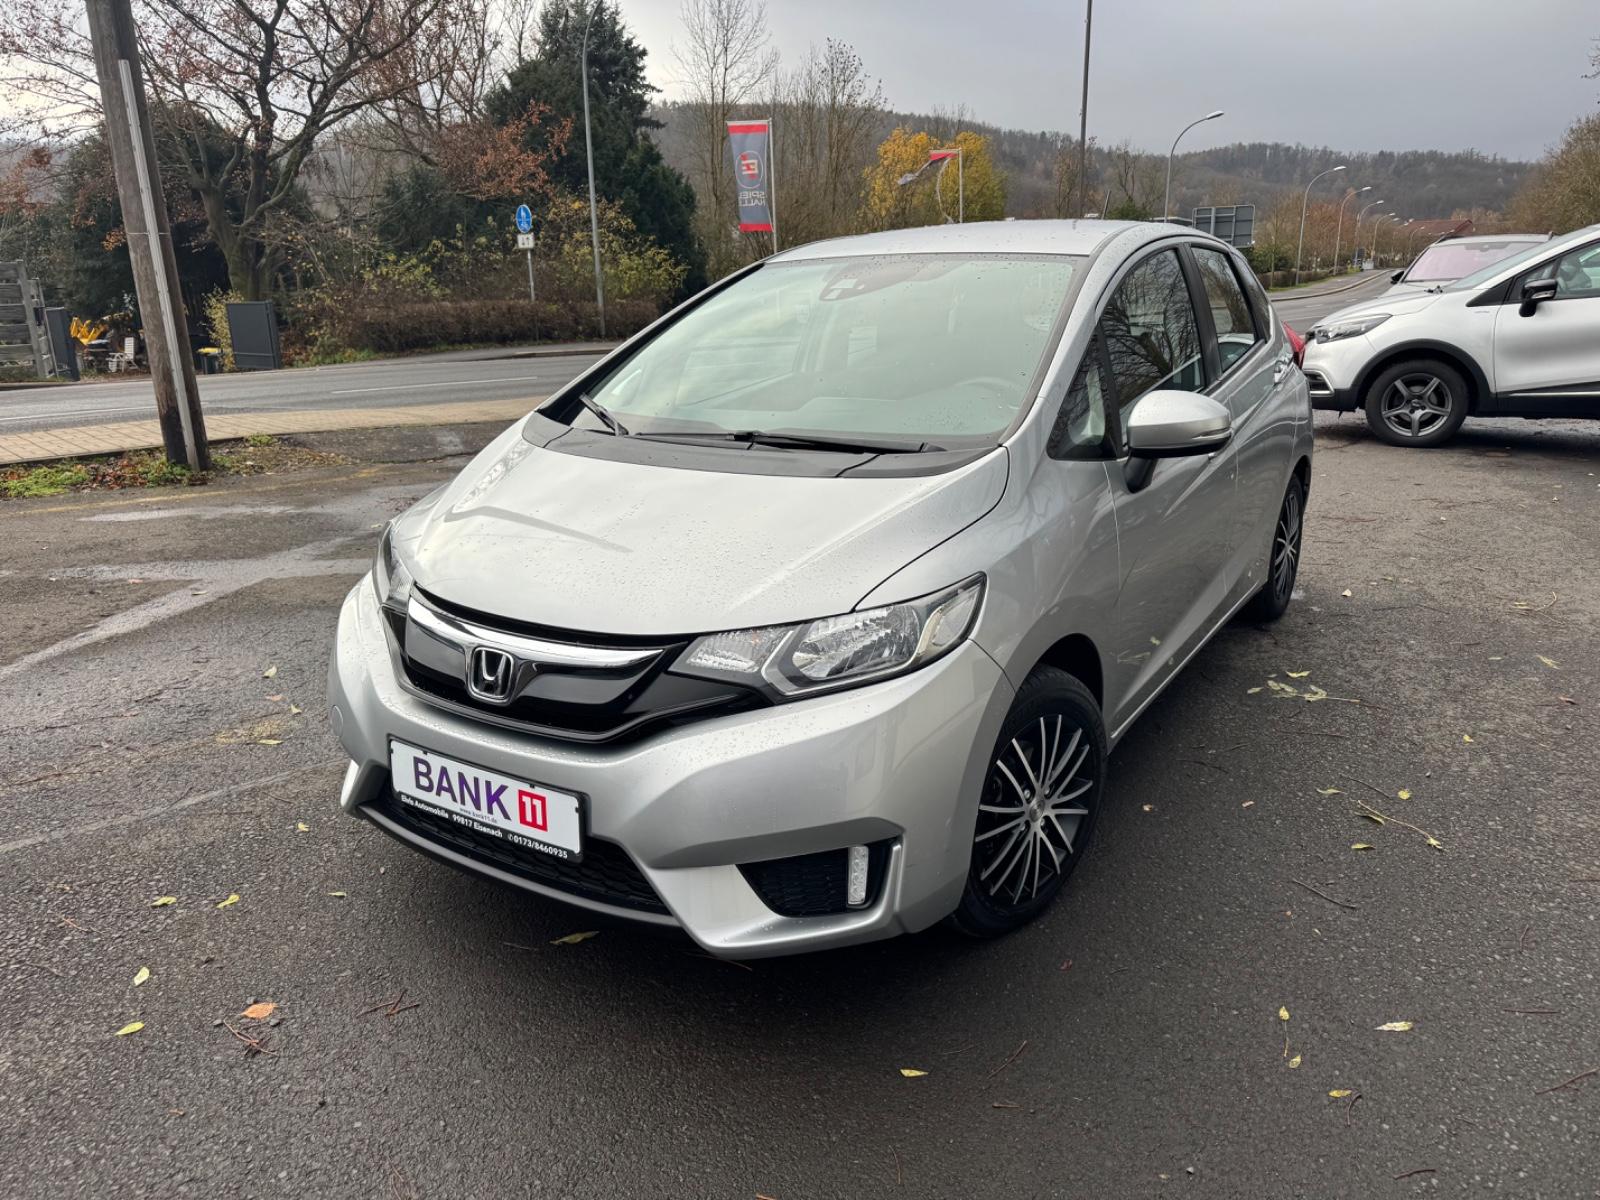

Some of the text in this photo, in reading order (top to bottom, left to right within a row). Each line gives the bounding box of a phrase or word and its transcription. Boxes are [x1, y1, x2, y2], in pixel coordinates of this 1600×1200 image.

[413, 756, 543, 826] BANK 11
[414, 800, 449, 819] Automobile
[452, 814, 473, 828] 99817
[473, 820, 503, 838] Eisenach
